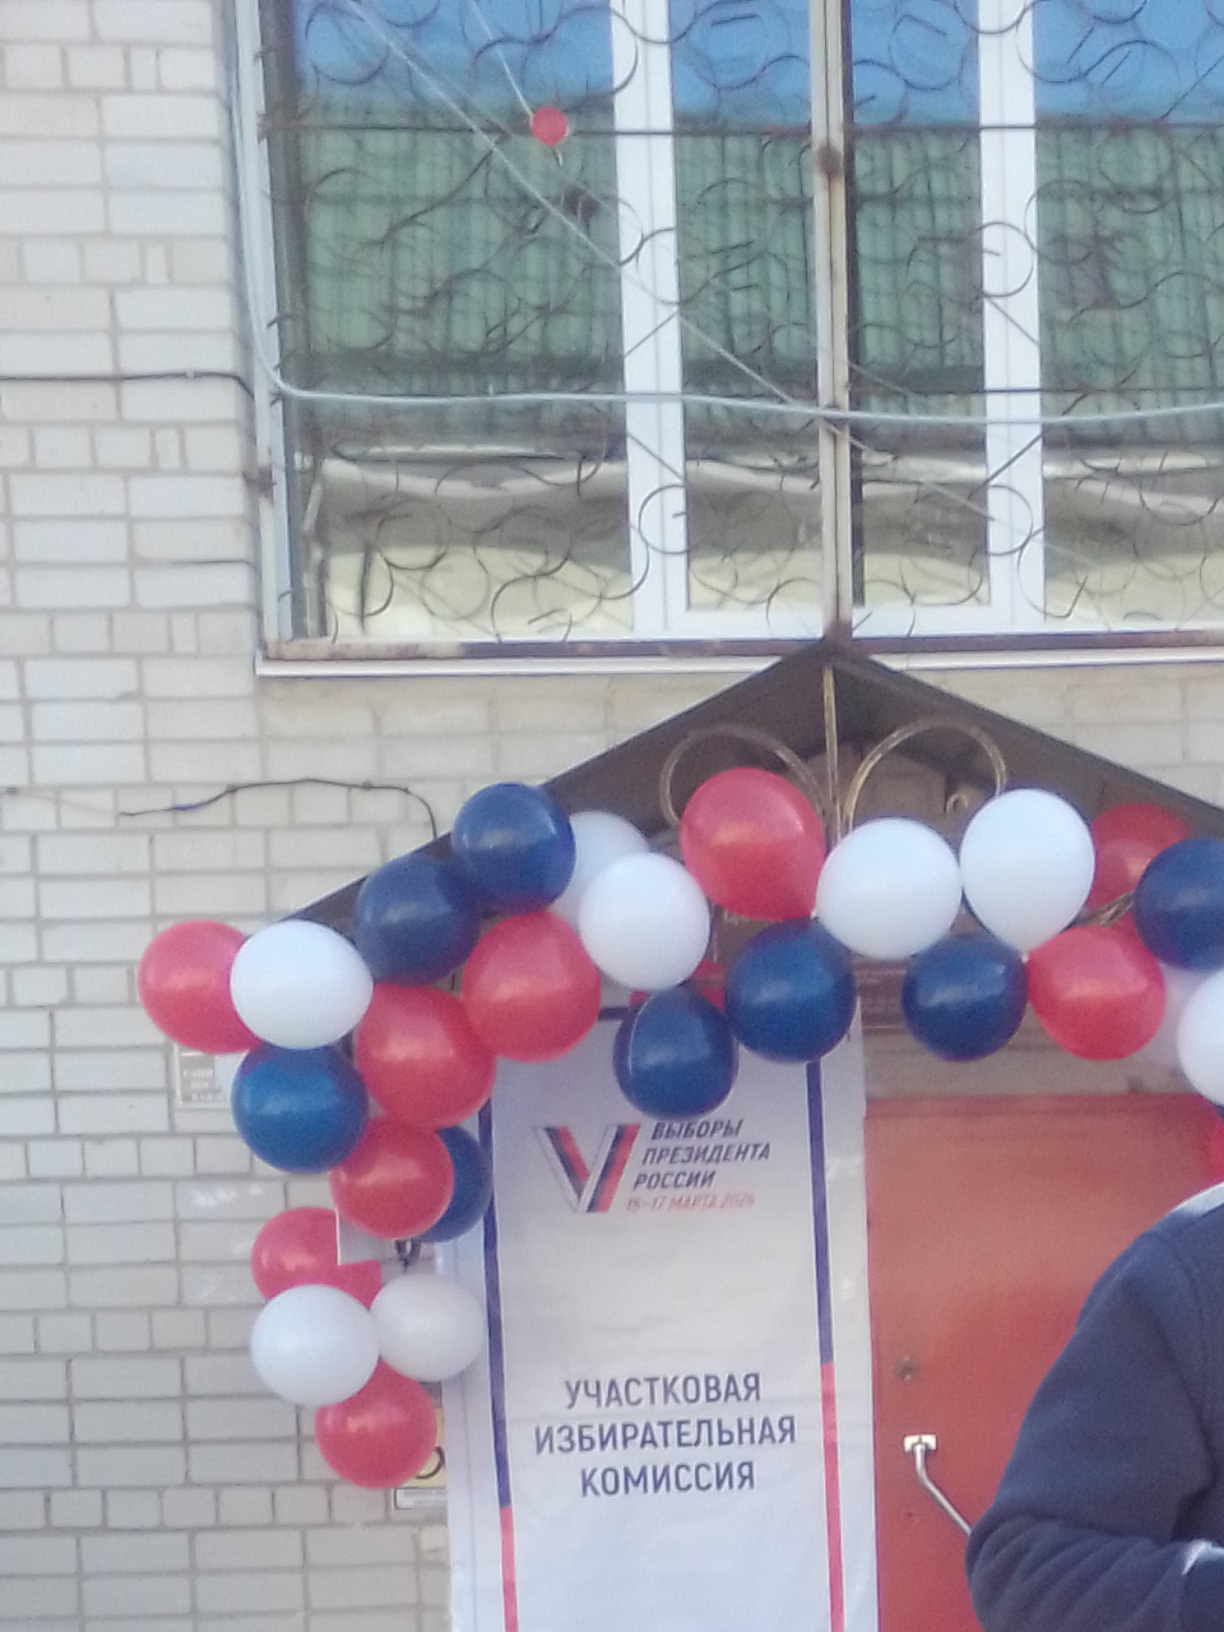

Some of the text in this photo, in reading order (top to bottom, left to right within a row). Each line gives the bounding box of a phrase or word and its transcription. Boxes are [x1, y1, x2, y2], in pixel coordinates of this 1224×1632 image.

[651, 1119, 743, 1140] ВЫБОРЫ
[642, 1143, 770, 1164] ПРЕЗИДЕНТА
[633, 1170, 716, 1190] РОССИИ
[565, 1373, 761, 1409] УЧАСТКОВАЯ
[534, 1416, 796, 1455] ИЗБИРАТЕЛЬНАЯ
[580, 1461, 756, 1497] КОМИССИЯ
